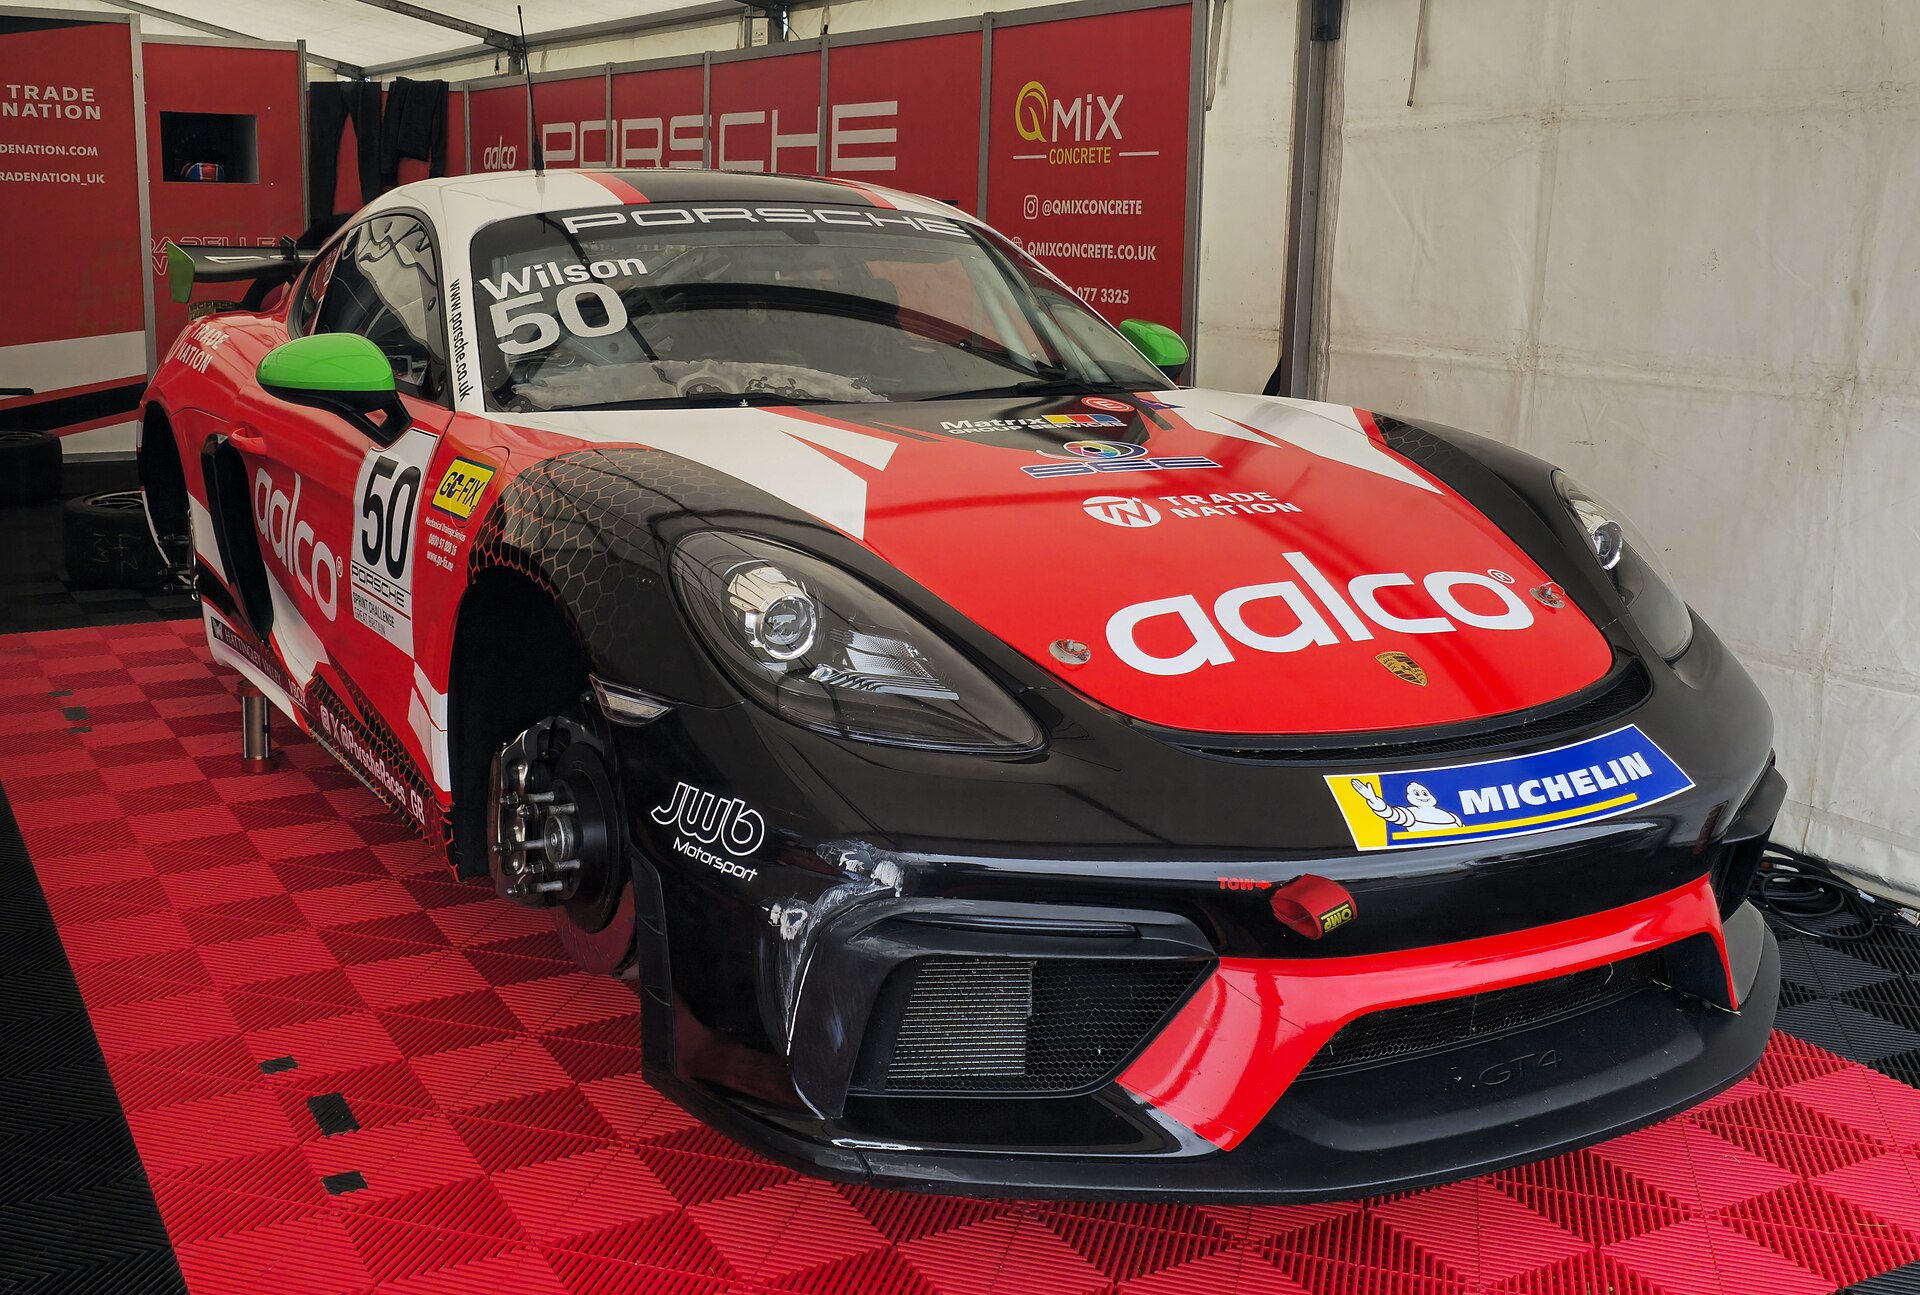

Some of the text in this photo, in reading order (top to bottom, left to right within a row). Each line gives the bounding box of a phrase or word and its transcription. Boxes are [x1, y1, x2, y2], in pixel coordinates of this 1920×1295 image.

[6, 84, 95, 102] TRADE
[2, 102, 101, 120] NATION
[542, 101, 898, 172] PORSCHE
[1049, 147, 1112, 164] CONCRETE
[1042, 199, 1143, 216] @QMIXCONCRETE
[561, 207, 972, 239] PORSCHE
[1027, 241, 1157, 261] QMIXCONCRETE.CO.UK
[479, 257, 649, 301] Wilson
[1076, 286, 1129, 304] 077 3325
[489, 282, 628, 355] 50
[190, 323, 230, 350] TRADE
[450, 278, 474, 402] www.porsche.co.uk
[175, 341, 213, 374] NATION
[940, 413, 1047, 430] Matrix
[949, 420, 1128, 435] GROUP SERVICES
[1158, 491, 1278, 506] TRADE
[1169, 502, 1303, 519] NATION
[361, 455, 422, 580] 50
[352, 564, 405, 608] PORSCHE
[353, 591, 395, 629] SPRINT CHALLENGE
[354, 606, 387, 637] GREAT BRITAIN
[1458, 751, 1653, 815] MICHELIN
[672, 836, 758, 882] Motorsport
[1216, 877, 1254, 890] TOW
[1324, 908, 1353, 932] OMP
